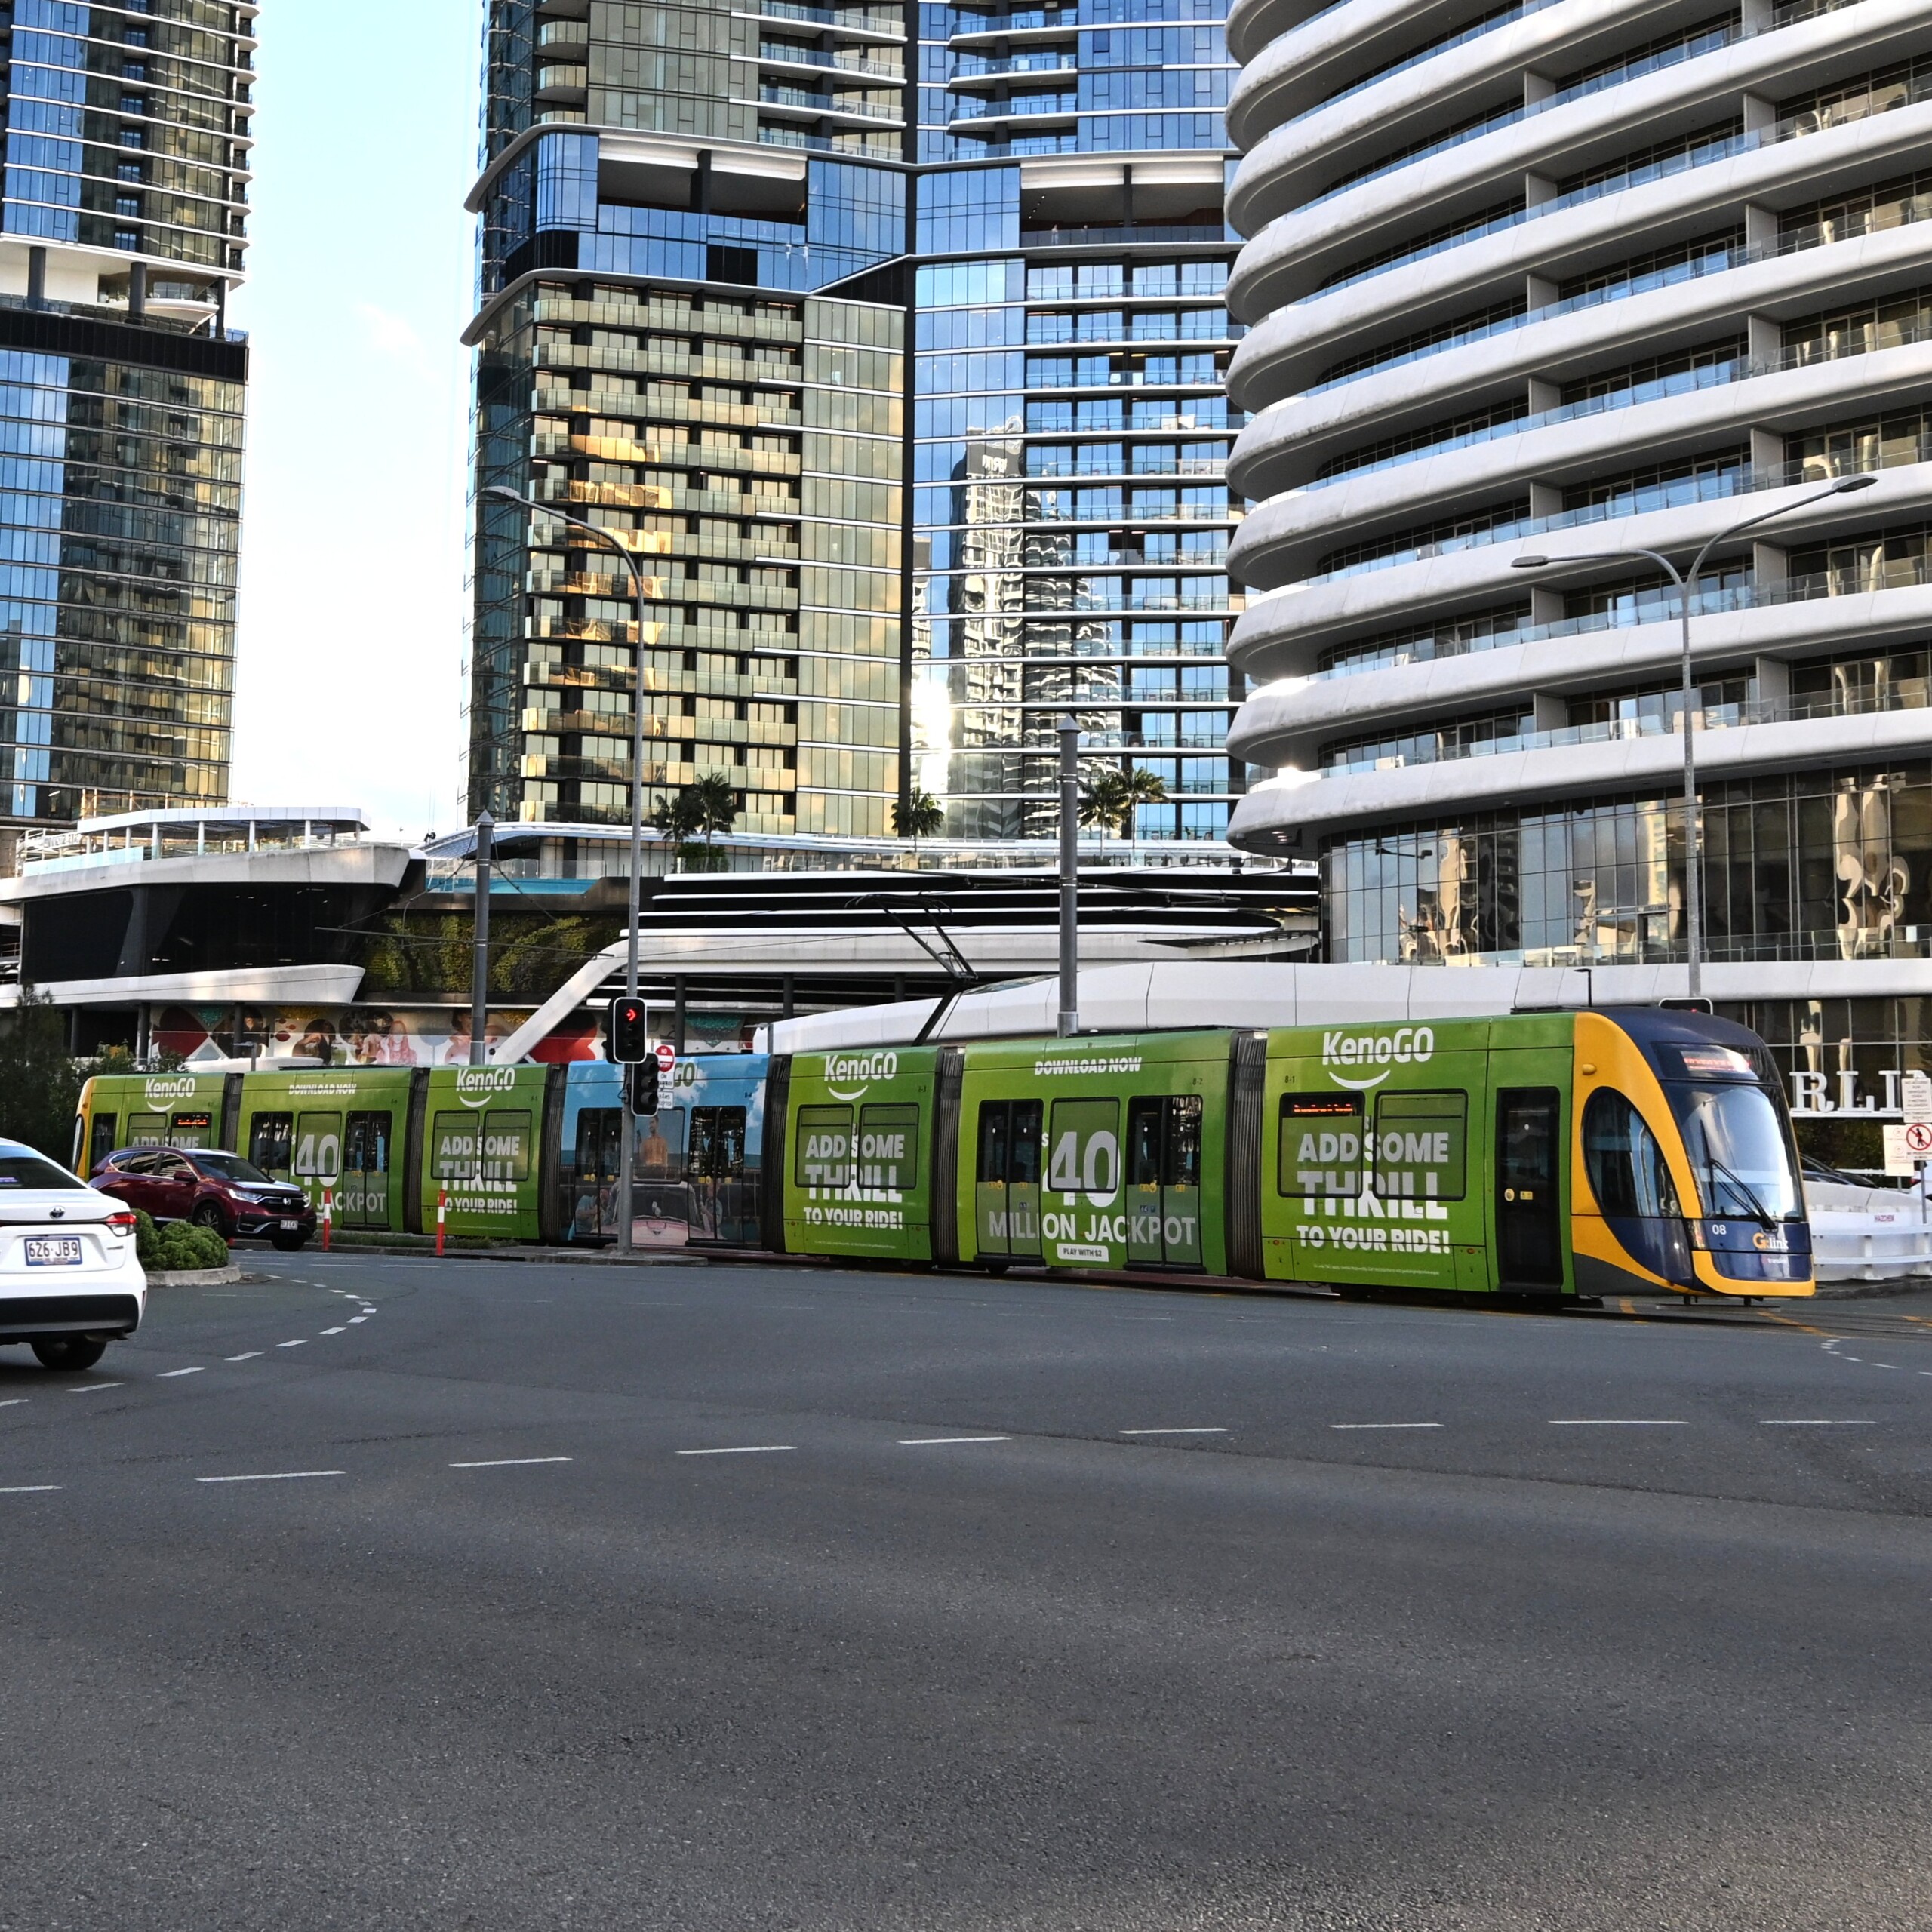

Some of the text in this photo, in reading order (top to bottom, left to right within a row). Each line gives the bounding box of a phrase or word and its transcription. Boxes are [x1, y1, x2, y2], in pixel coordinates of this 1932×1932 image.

[1322, 1026, 1434, 1066] KenoGO
[456, 1067, 515, 1091] KenoGO
[824, 1052, 897, 1081] KenoGO
[1035, 1057, 1142, 1075] DOWNLOAD NOW
[145, 1077, 195, 1098] KenoGO
[289, 1084, 357, 1095] DOWNLOAD NOW
[1789, 1069, 1927, 1112] RLI
[439, 1136, 520, 1155] ADD SOME
[805, 1134, 905, 1158] ADD SOME
[1297, 1132, 1448, 1163] ADD SOME
[439, 1161, 517, 1192] THRILL
[805, 1164, 903, 1203] THRILL
[454, 1198, 485, 1213] YOUR
[487, 1198, 517, 1214] RIDE!
[1297, 1171, 1447, 1220] THRILL
[804, 1208, 903, 1230] TO YOUR RIDE!
[989, 1211, 1196, 1245] MILLION JACKPOT
[1712, 1224, 1727, 1235] 08
[1297, 1226, 1451, 1254] TO YOUR RIDE!
